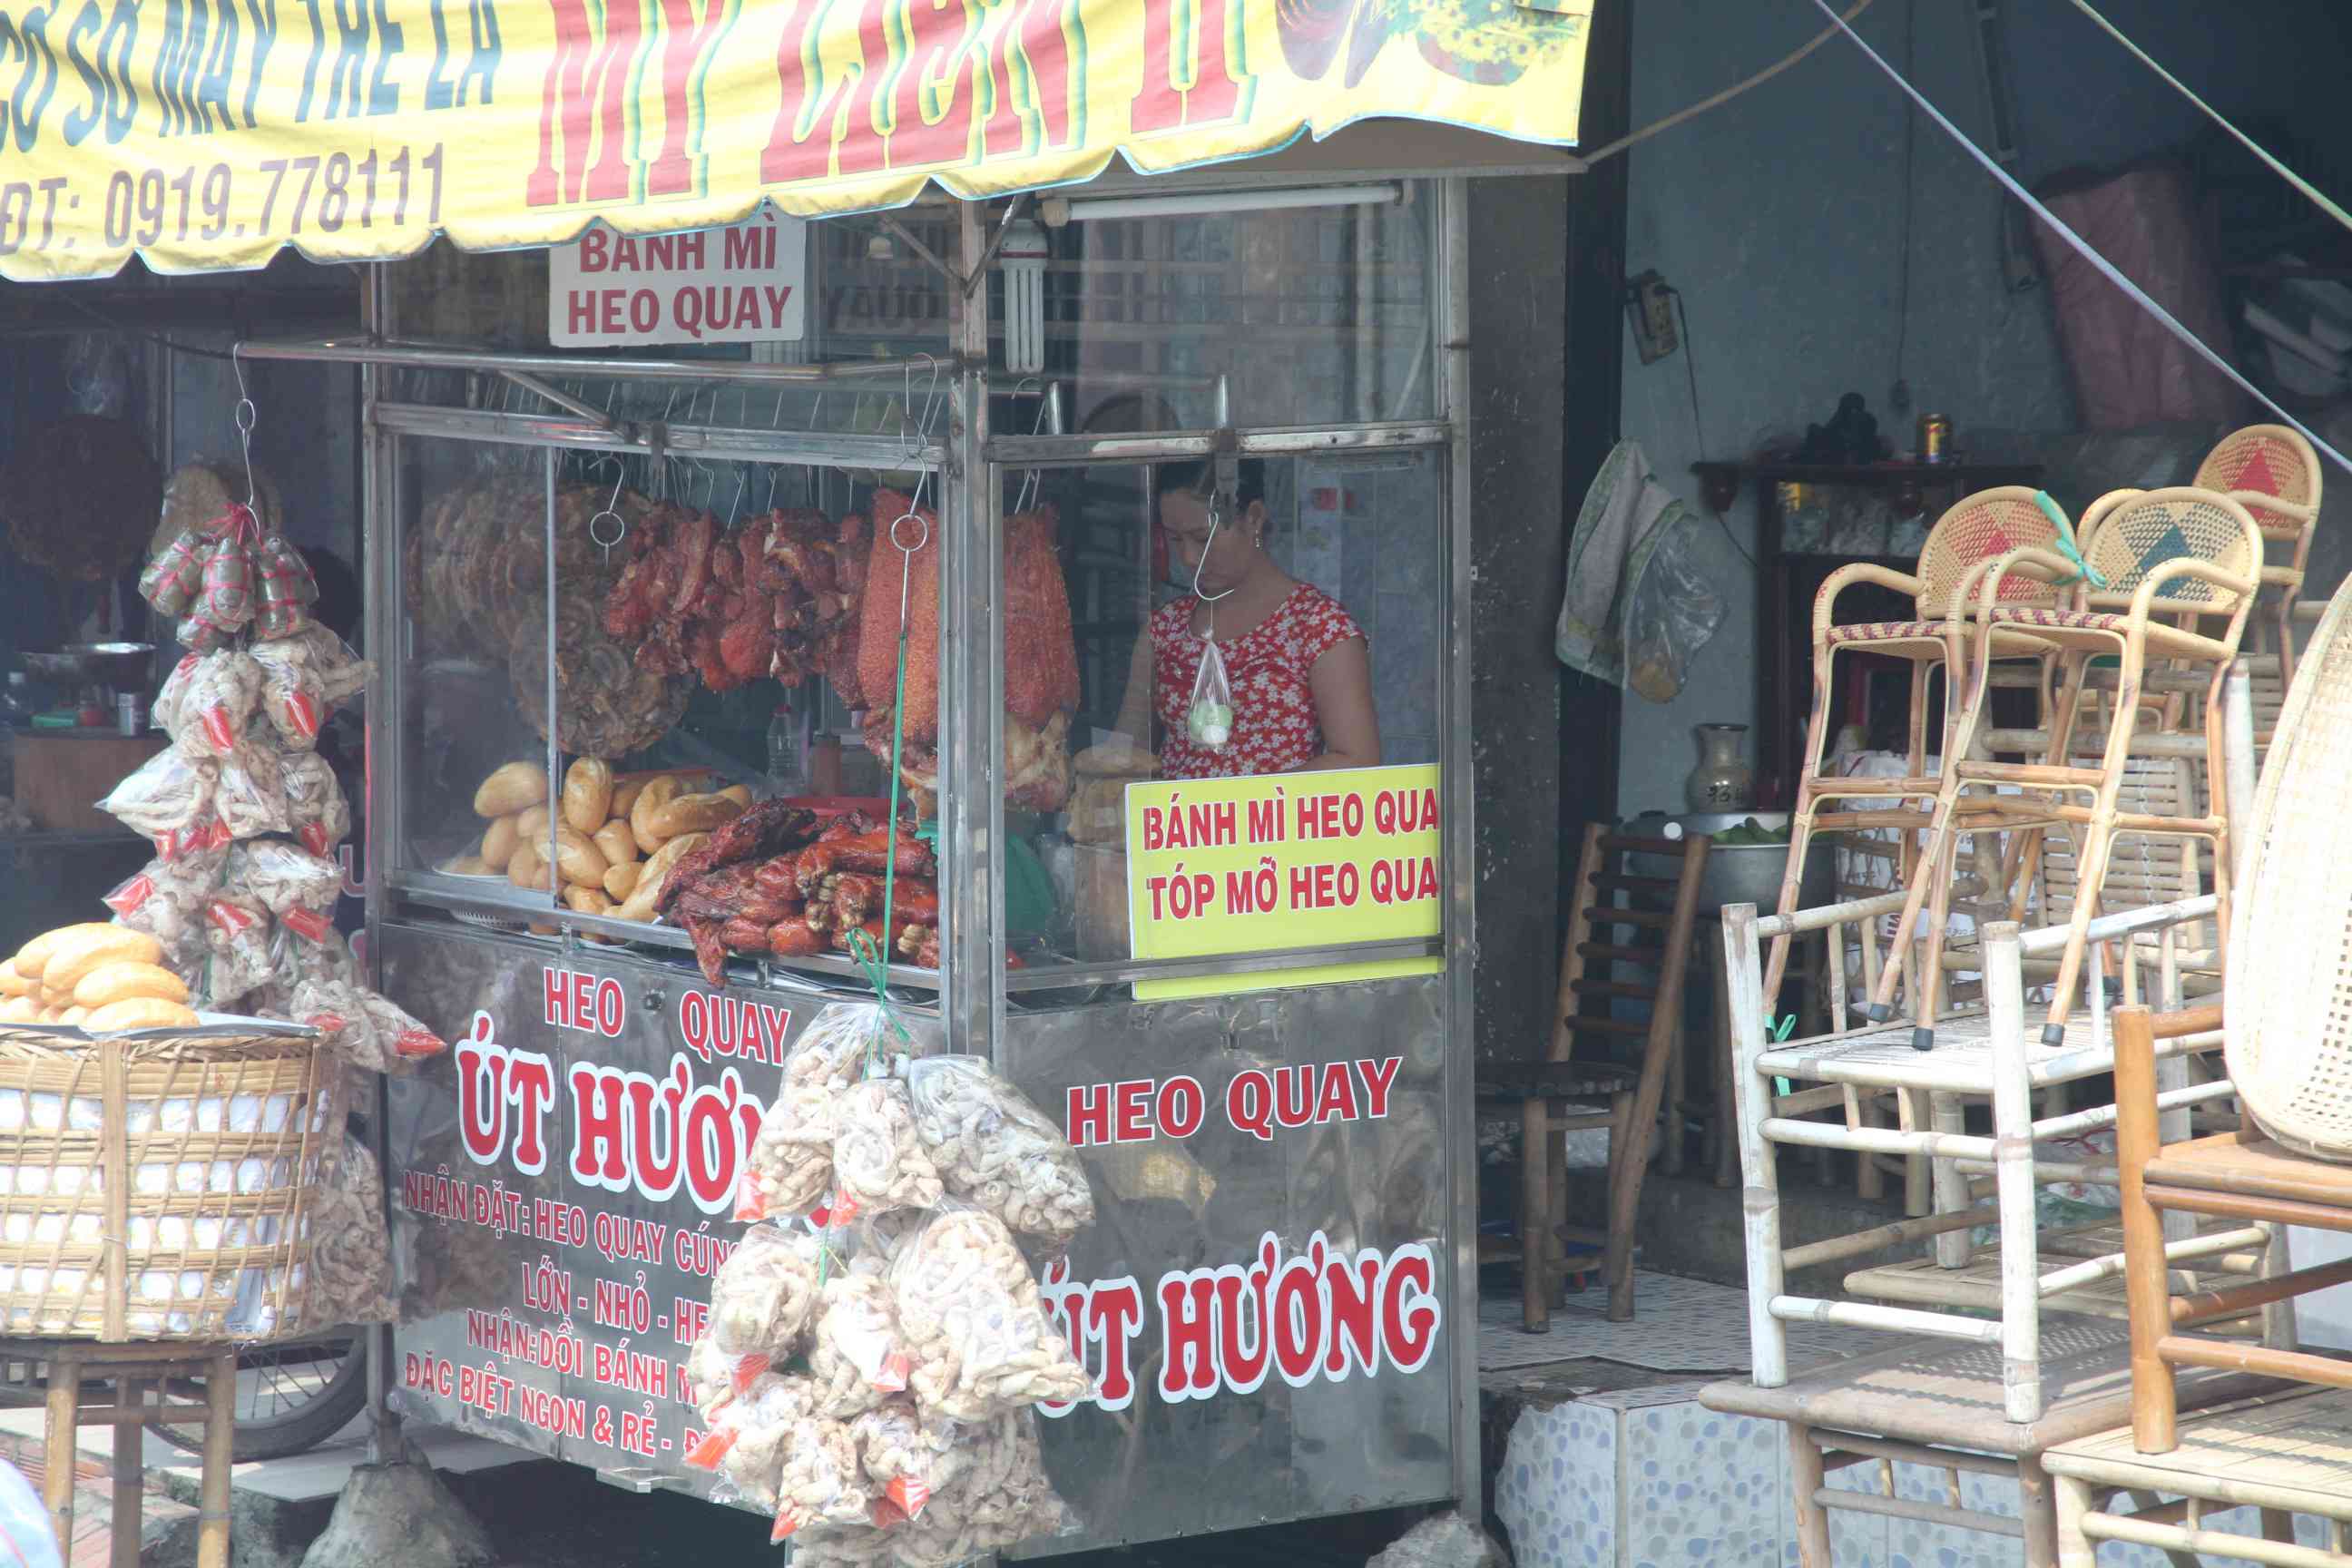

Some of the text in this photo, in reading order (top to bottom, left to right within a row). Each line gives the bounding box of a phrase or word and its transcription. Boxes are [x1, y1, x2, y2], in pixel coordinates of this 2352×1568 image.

[104, 142, 444, 248] 0919.778111
[724, 213, 778, 270] MÌ
[568, 286, 792, 338] HEO QUAY
[1142, 786, 1439, 851] BÁNH MÌ HEO QUA
[1146, 862, 1216, 921] TÓP
[1289, 860, 1359, 910] HEO
[1370, 856, 1440, 906] QUA
[544, 967, 791, 1067] HEO QUAY
[456, 1010, 555, 1176] ÚT
[1067, 1055, 1403, 1148] HEO QUAY
[405, 1163, 739, 1278] NHẬN ĐẶT: HEO QUAY CÚN
[522, 1255, 571, 1316] LỚN
[594, 1270, 651, 1334] NHỎ
[1158, 1230, 1441, 1404] HƯƠNG
[406, 1352, 452, 1402] ĐẶC
[459, 1361, 514, 1422] BIỆT
[520, 1385, 586, 1439] NGON
[593, 1404, 613, 1446] &
[622, 1401, 656, 1457] RẺ
[594, 1338, 667, 1398] BÁNH
